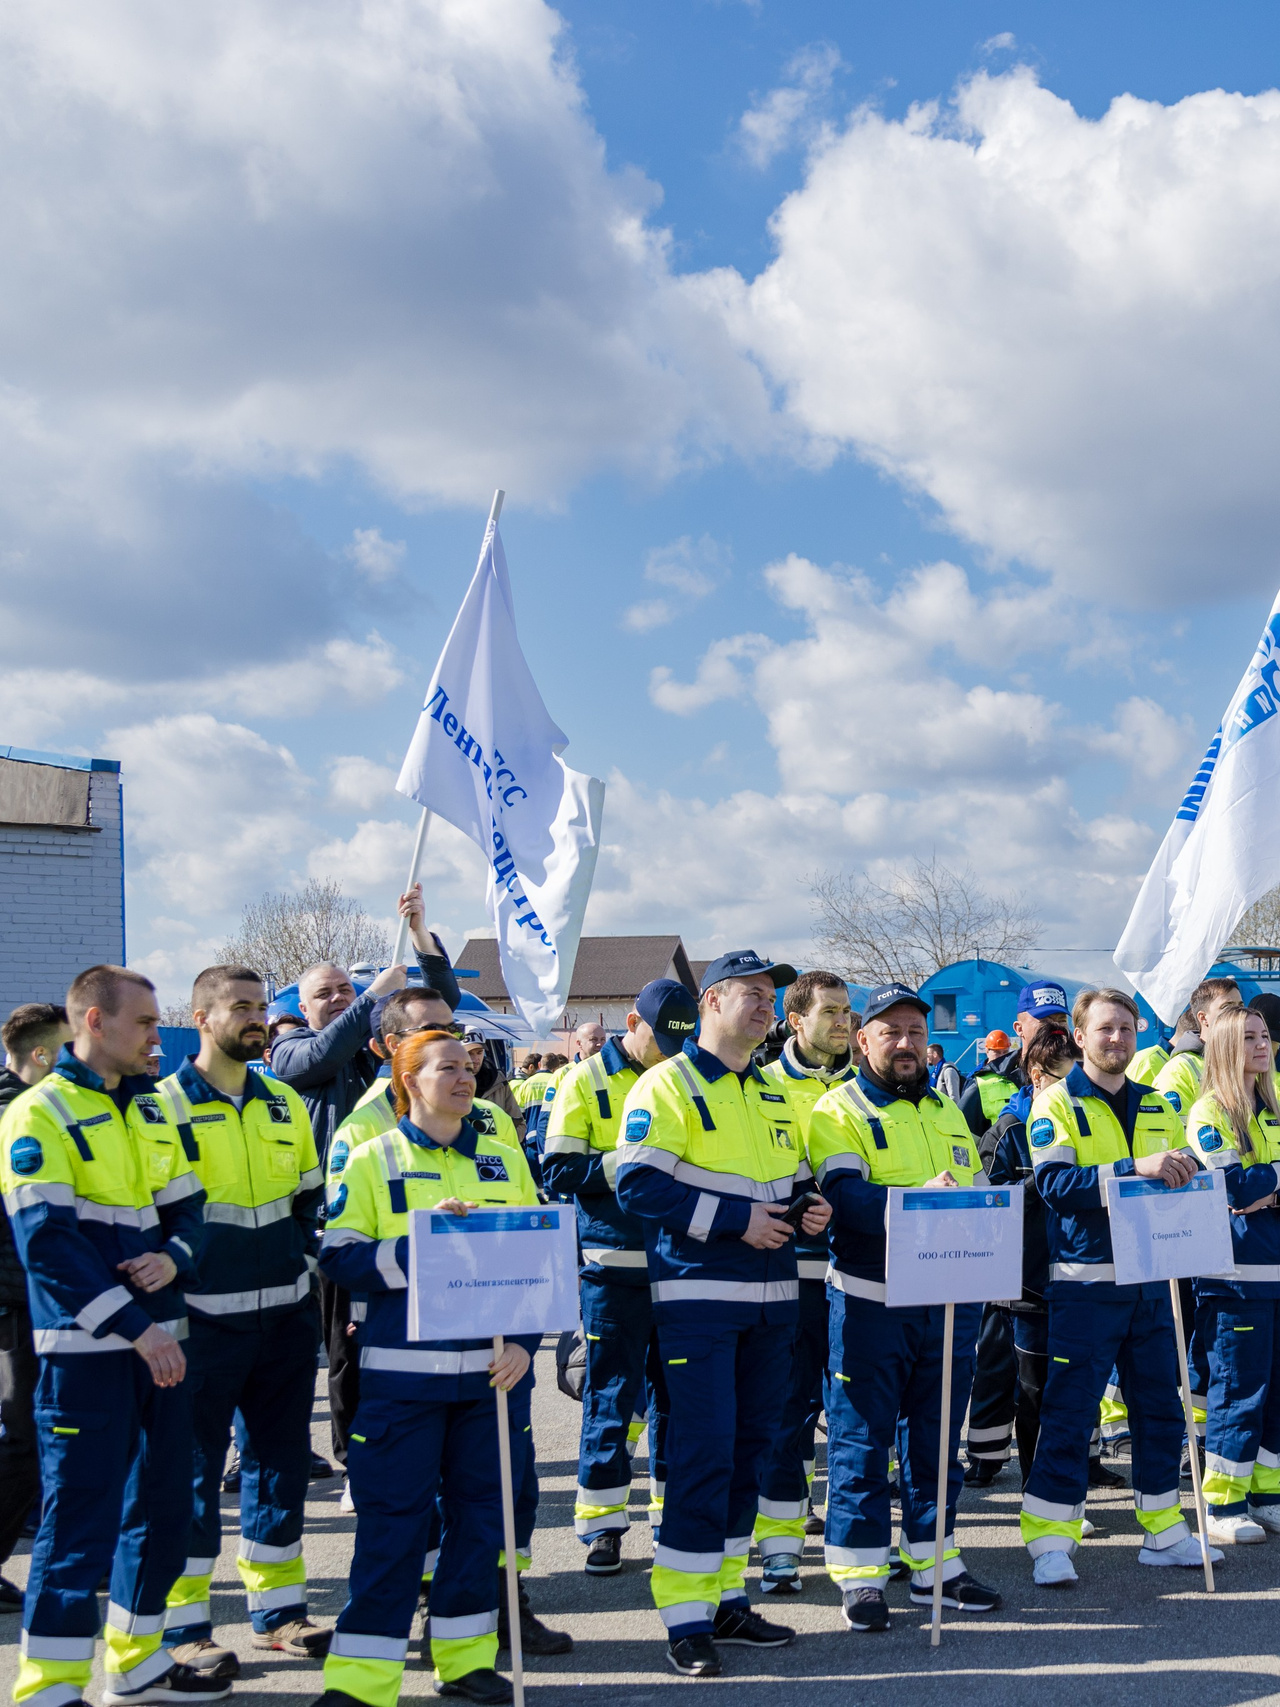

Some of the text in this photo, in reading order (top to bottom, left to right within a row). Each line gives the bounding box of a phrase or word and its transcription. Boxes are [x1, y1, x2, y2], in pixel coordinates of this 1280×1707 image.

[877, 989, 893, 1001] ГСП
[667, 1020, 680, 1030] ГСП
[475, 1155, 503, 1165] ЛГСС
[1152, 1229, 1192, 1241] Сборная №2
[918, 1250, 994, 1261] ООО «ГСП Ремонт»
[447, 1276, 550, 1290] АО «Ленгазспецстрой»
